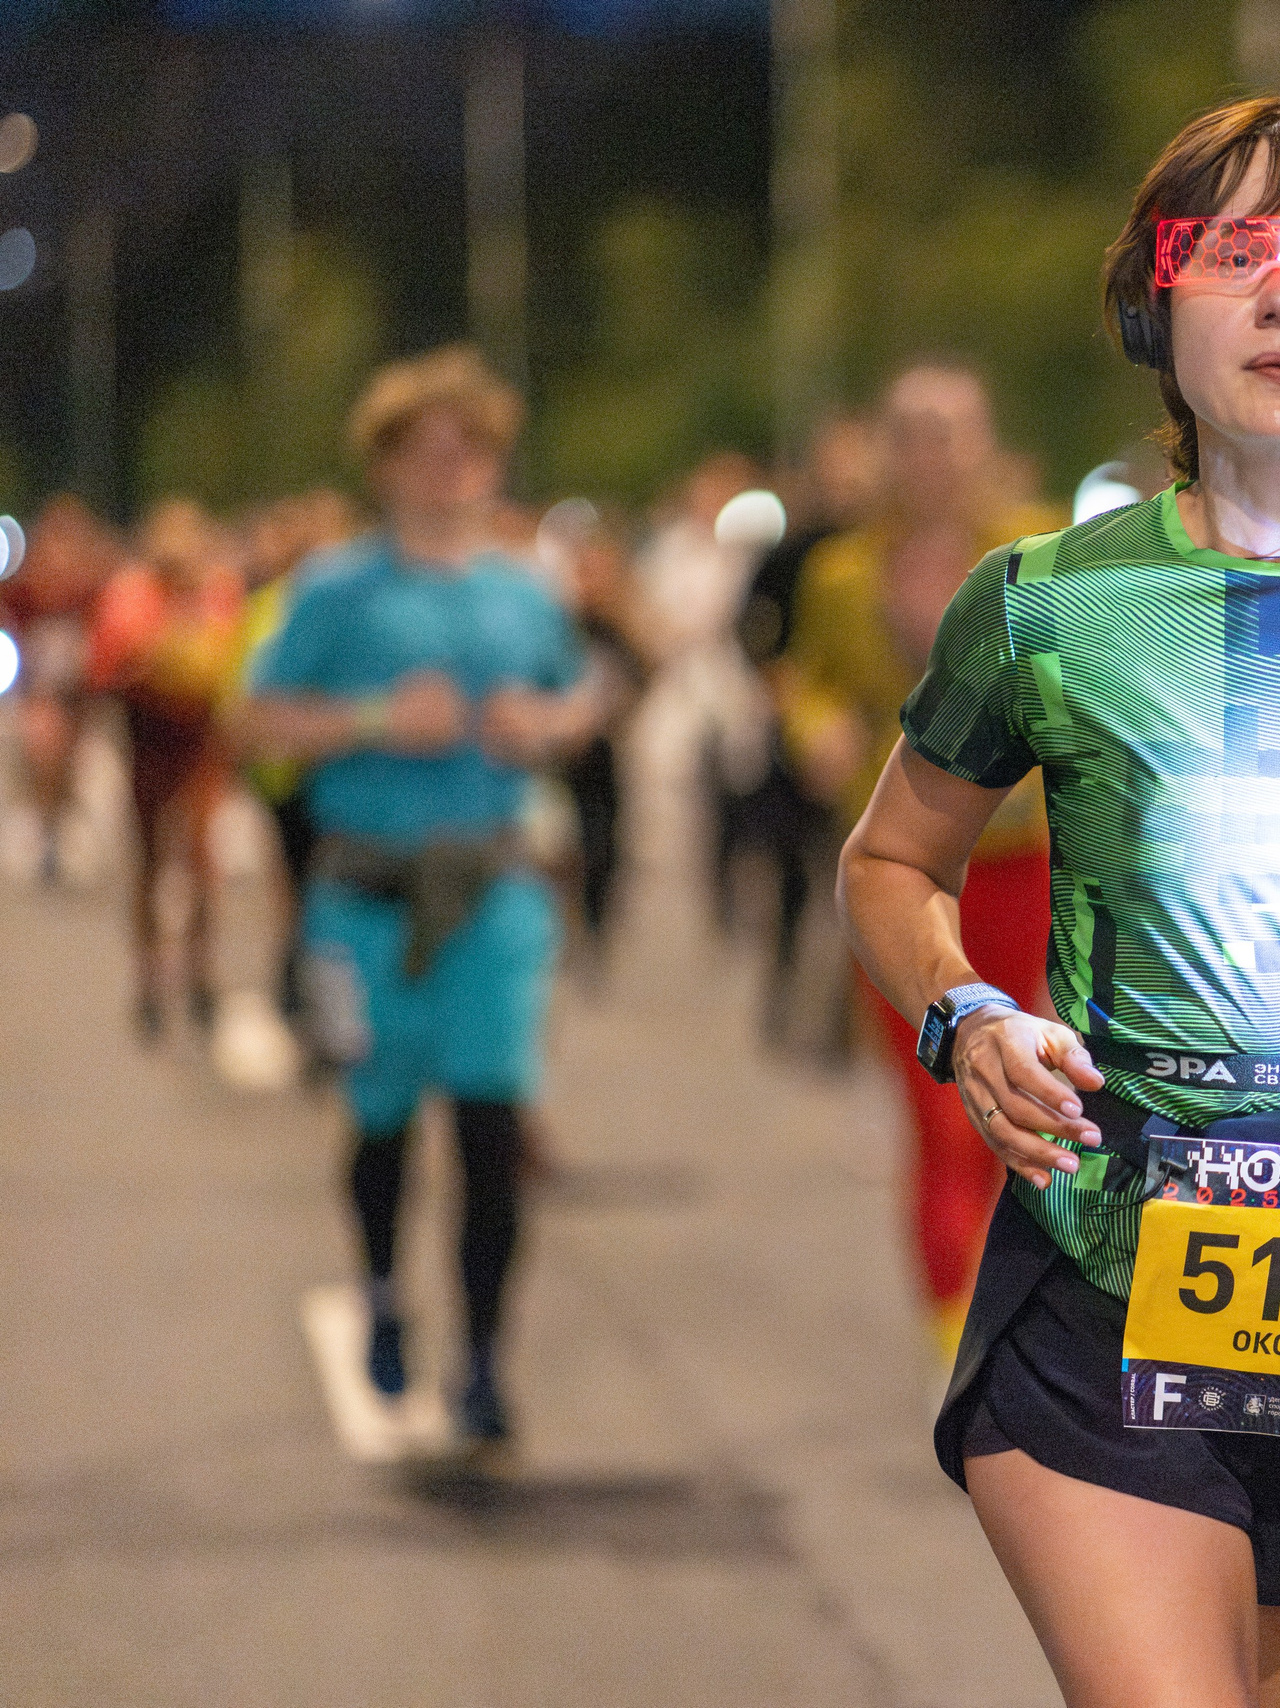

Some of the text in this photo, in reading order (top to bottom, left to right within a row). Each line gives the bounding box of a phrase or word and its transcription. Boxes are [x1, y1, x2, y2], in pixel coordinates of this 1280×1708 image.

[1144, 1051, 1237, 1085] ЭРА
[1162, 1183, 1278, 1209] 2025
[1153, 1372, 1188, 1421] F
